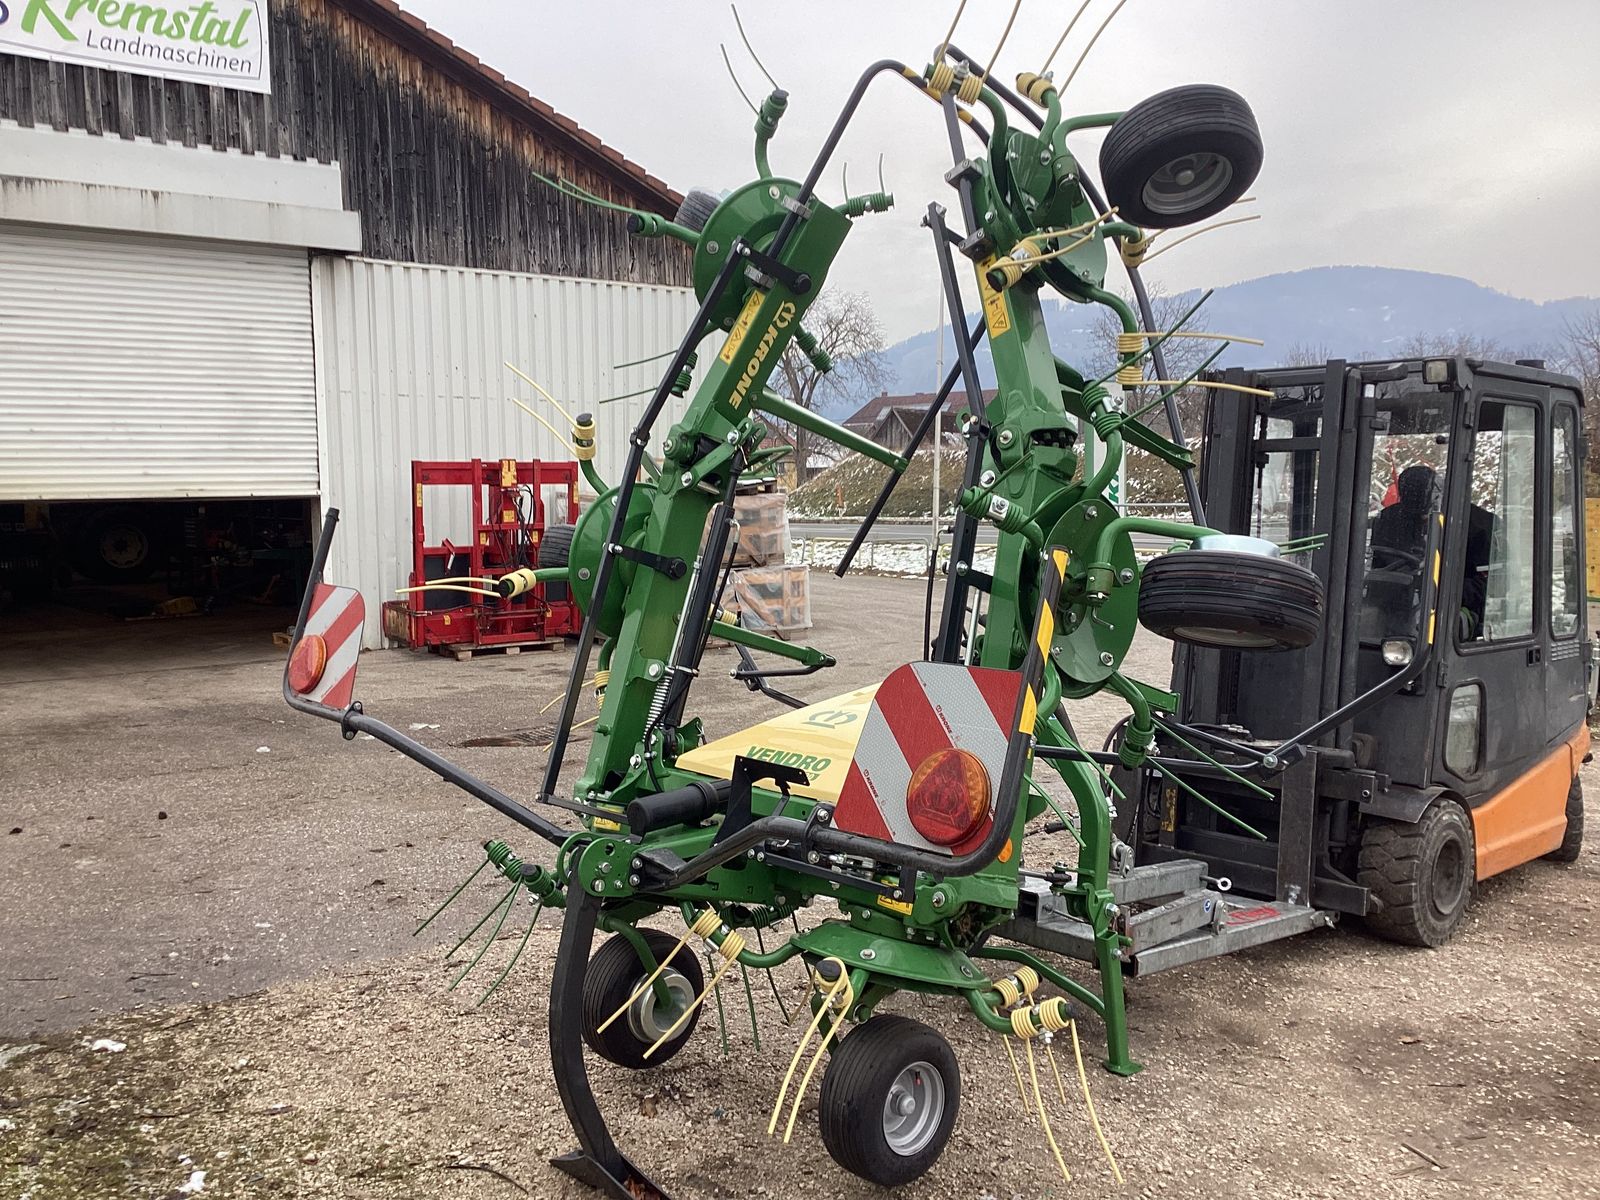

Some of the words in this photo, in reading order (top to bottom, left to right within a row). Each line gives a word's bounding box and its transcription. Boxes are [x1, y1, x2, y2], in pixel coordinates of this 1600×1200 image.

[21, 0, 252, 48] Kremstal
[86, 29, 252, 73] Landmaschinen
[729, 324, 778, 410] KRONE
[746, 745, 832, 772] VENDRO
